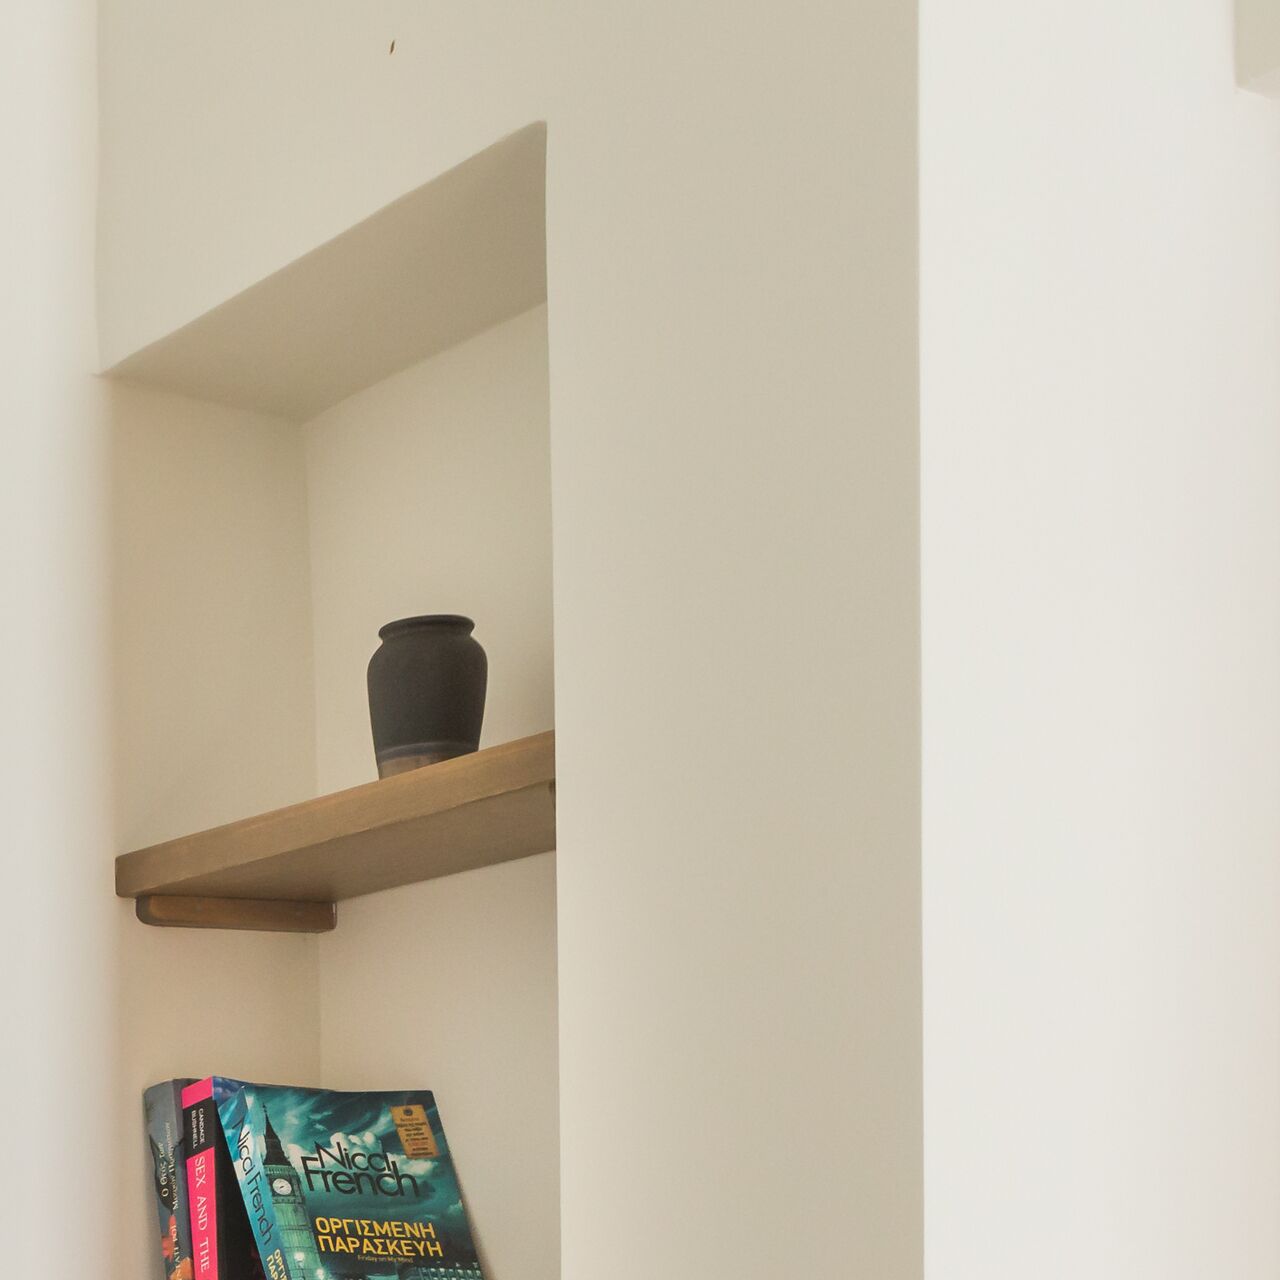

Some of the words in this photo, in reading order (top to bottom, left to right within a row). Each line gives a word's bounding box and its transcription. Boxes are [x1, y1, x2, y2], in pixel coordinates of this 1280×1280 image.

[191, 1110, 199, 1149] BUSHNELL
[198, 1108, 206, 1144] CANDACE
[194, 1156, 206, 1188] SEX
[314, 1141, 392, 1174] Nicci
[301, 1156, 420, 1197] French
[197, 1195, 208, 1231] AND
[247, 1171, 273, 1246] French
[315, 1216, 436, 1239] ΟΡΓΙΣΜΕΝΗ
[199, 1237, 210, 1273] THE
[318, 1235, 444, 1257] ΠΑΡΑΣΚΕΥΗ
